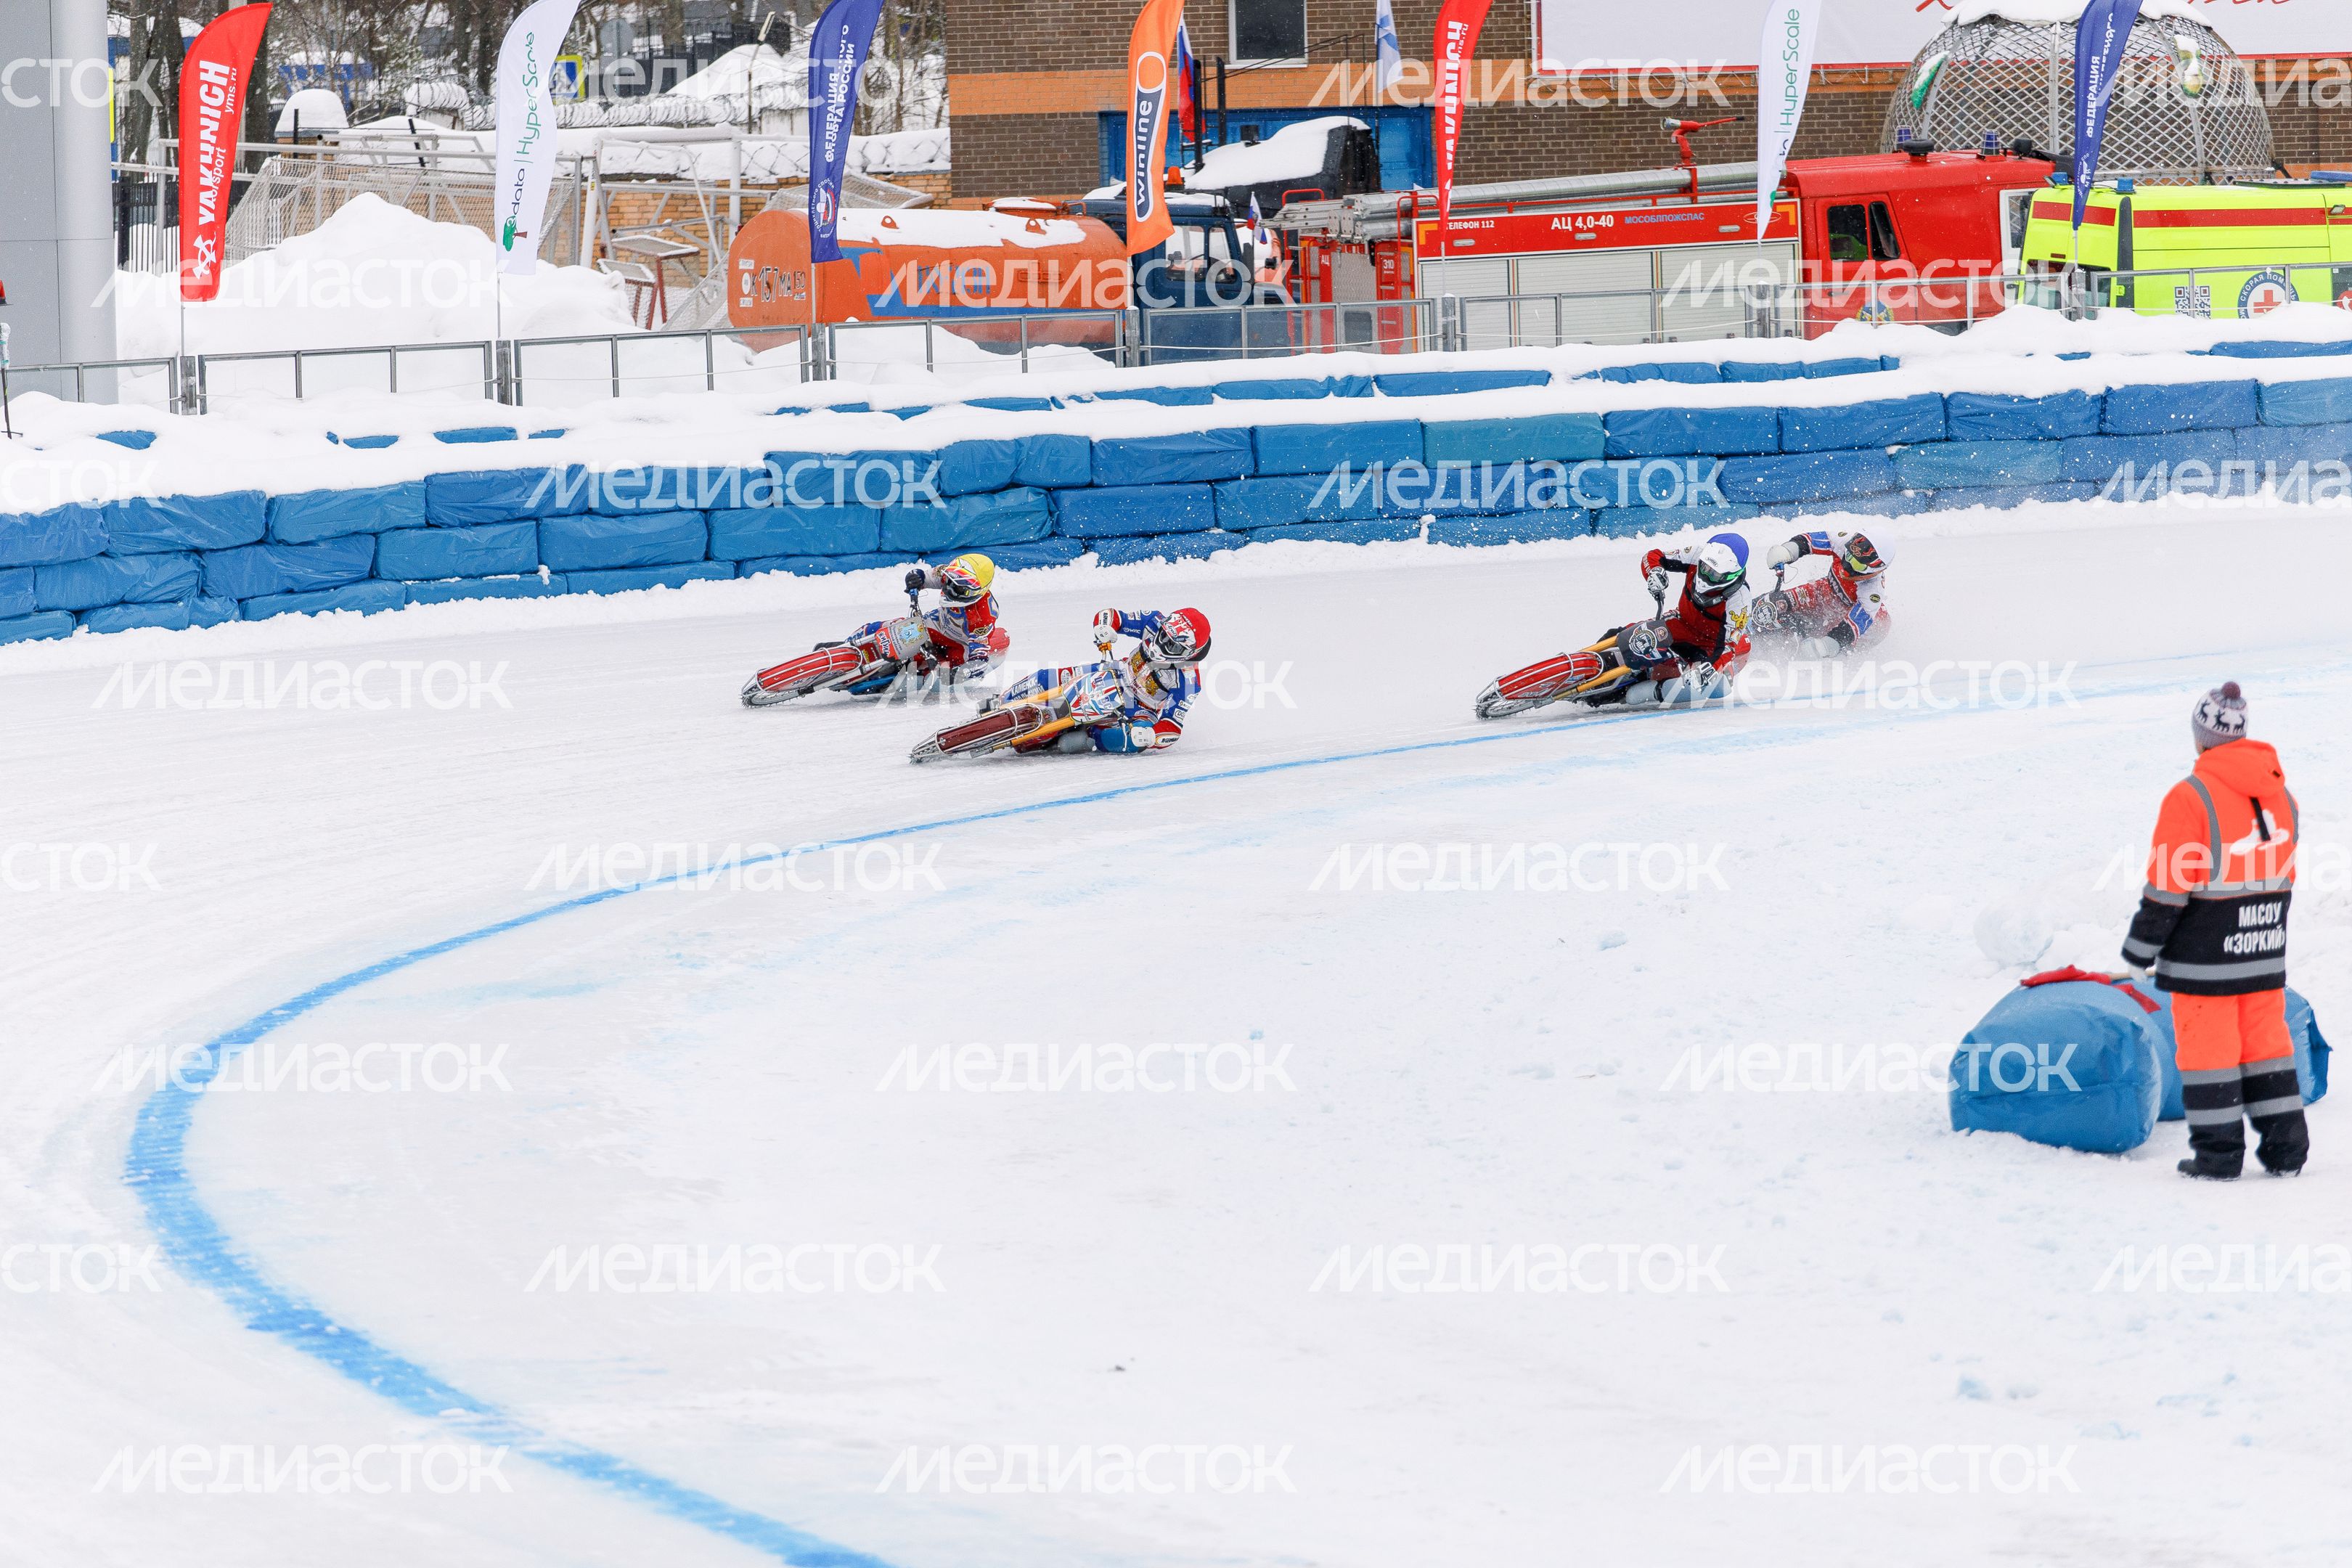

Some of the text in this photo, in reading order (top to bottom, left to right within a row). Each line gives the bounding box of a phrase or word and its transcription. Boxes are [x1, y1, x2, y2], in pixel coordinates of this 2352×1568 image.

[224, 67, 237, 115] yms.ru
[837, 43, 855, 105] РОССИИ
[1780, 8, 1800, 126] HyperScale
[825, 73, 841, 163] ФЕДЕРАЦИЯ
[2086, 55, 2100, 138] ФЕДЕРАЦИЯ
[199, 60, 230, 226] YAKUNICH
[1136, 99, 1153, 206] winline
[1446, 220, 1495, 230] ЕЛЕФОН 112
[1551, 214, 1614, 232] АЦ 4,0-40
[1625, 212, 1705, 225] МОСОБЛПОЖСПАС
[2240, 274, 2265, 302] СКОРАЯ
[2239, 901, 2283, 928] МАСОУ
